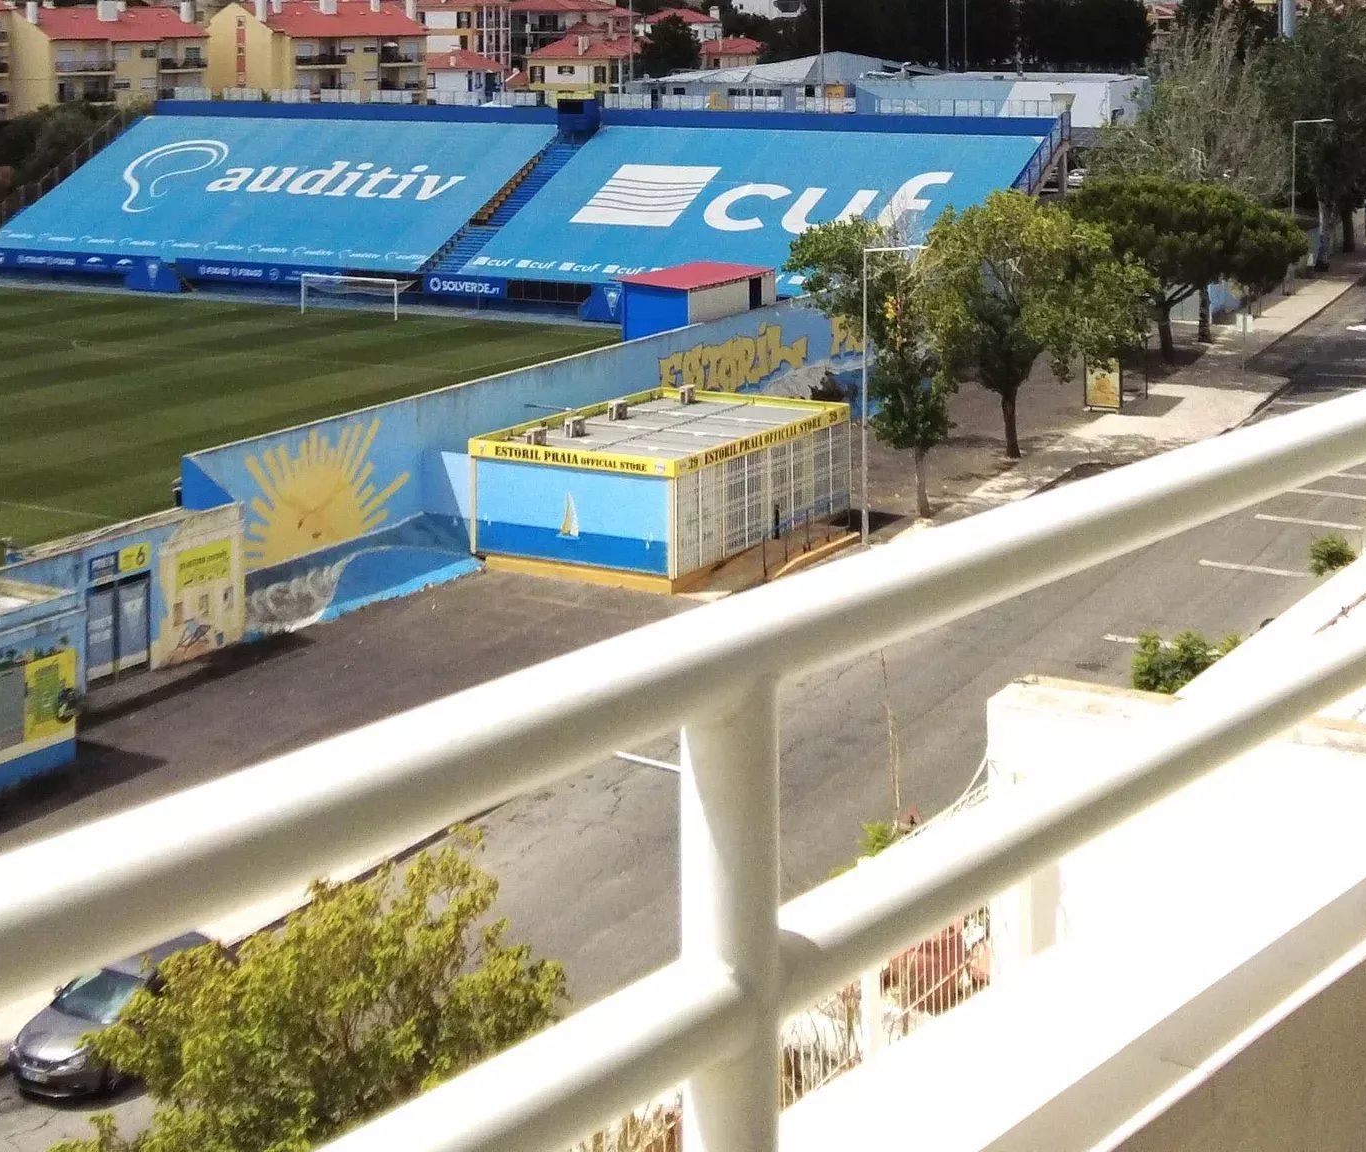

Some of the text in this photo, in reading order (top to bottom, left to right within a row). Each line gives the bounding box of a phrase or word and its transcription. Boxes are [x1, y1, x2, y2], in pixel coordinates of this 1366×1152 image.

[205, 160, 467, 201] auditiv
[703, 171, 954, 235] cuf
[487, 257, 515, 267] cuf
[529, 260, 558, 270] cuf
[572, 263, 603, 273] cuf
[617, 266, 646, 275] cuf
[704, 445, 738, 465] ESTORIL
[739, 435, 764, 454] PRAIA
[764, 427, 797, 445] OFFICIAL
[799, 416, 822, 433] STORE
[494, 445, 648, 473] ESTORIL PRAIA OFFICIAL STORE
